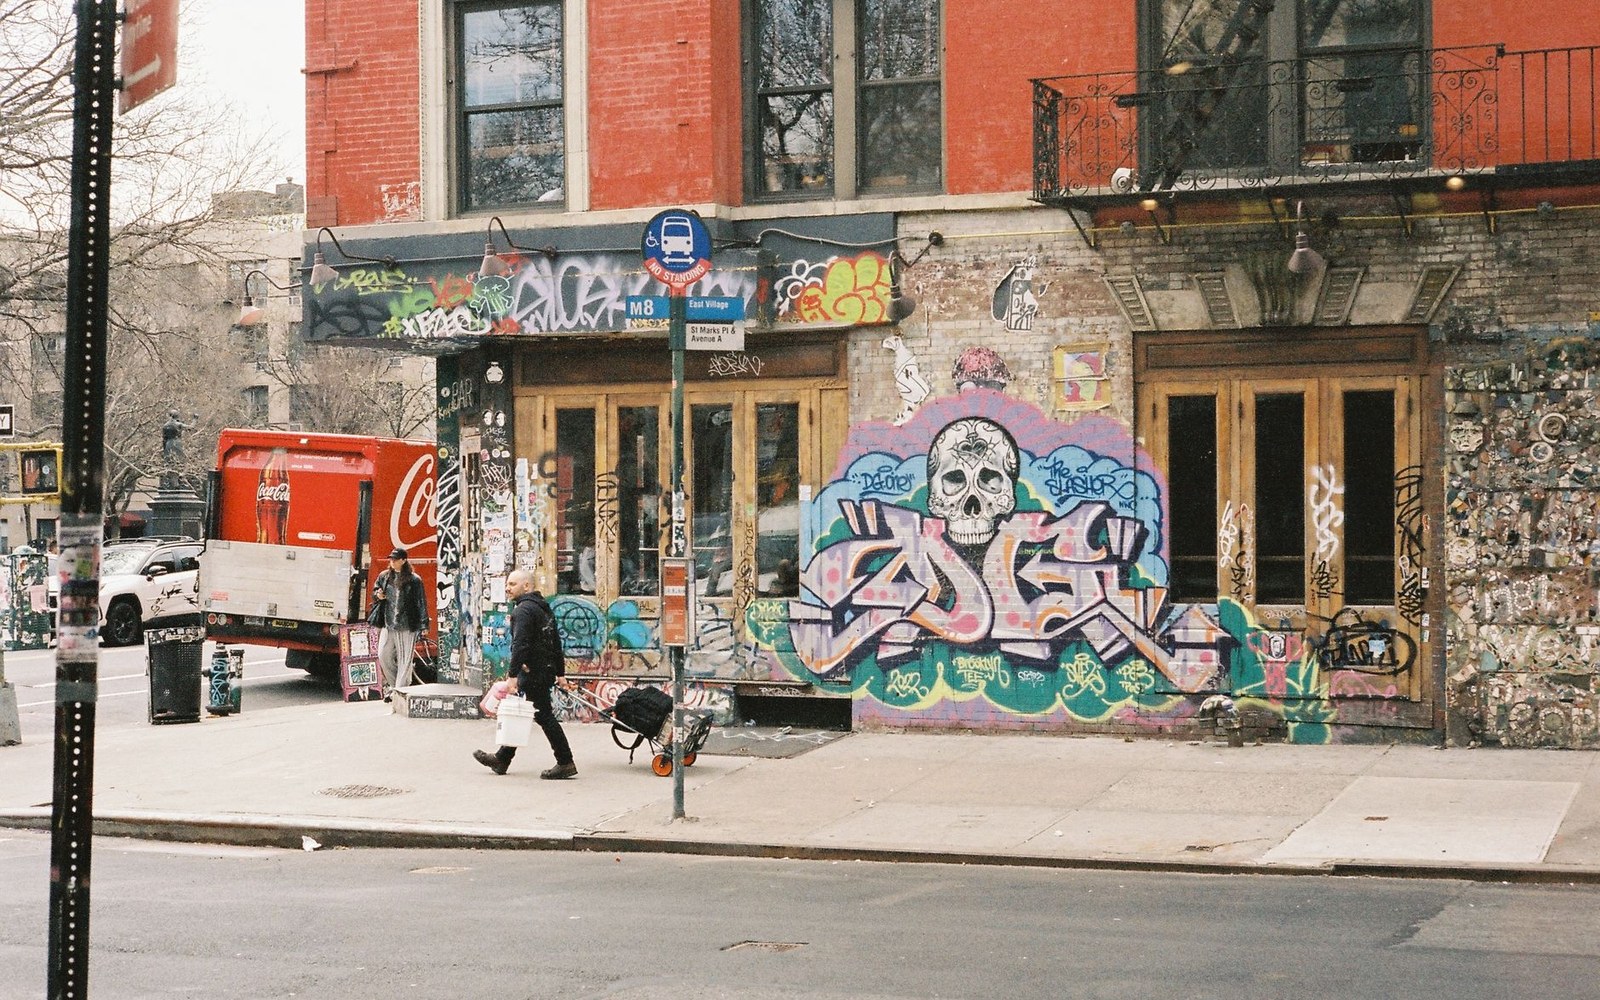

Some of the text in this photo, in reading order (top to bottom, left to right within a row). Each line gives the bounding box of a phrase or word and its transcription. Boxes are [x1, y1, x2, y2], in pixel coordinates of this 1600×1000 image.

[648, 262, 705, 282] NO STANDING
[630, 299, 654, 316] M8
[689, 300, 729, 310] East Village
[690, 326, 698, 334] St
[700, 326, 720, 334] Marks
[691, 335, 716, 343] Avenue
